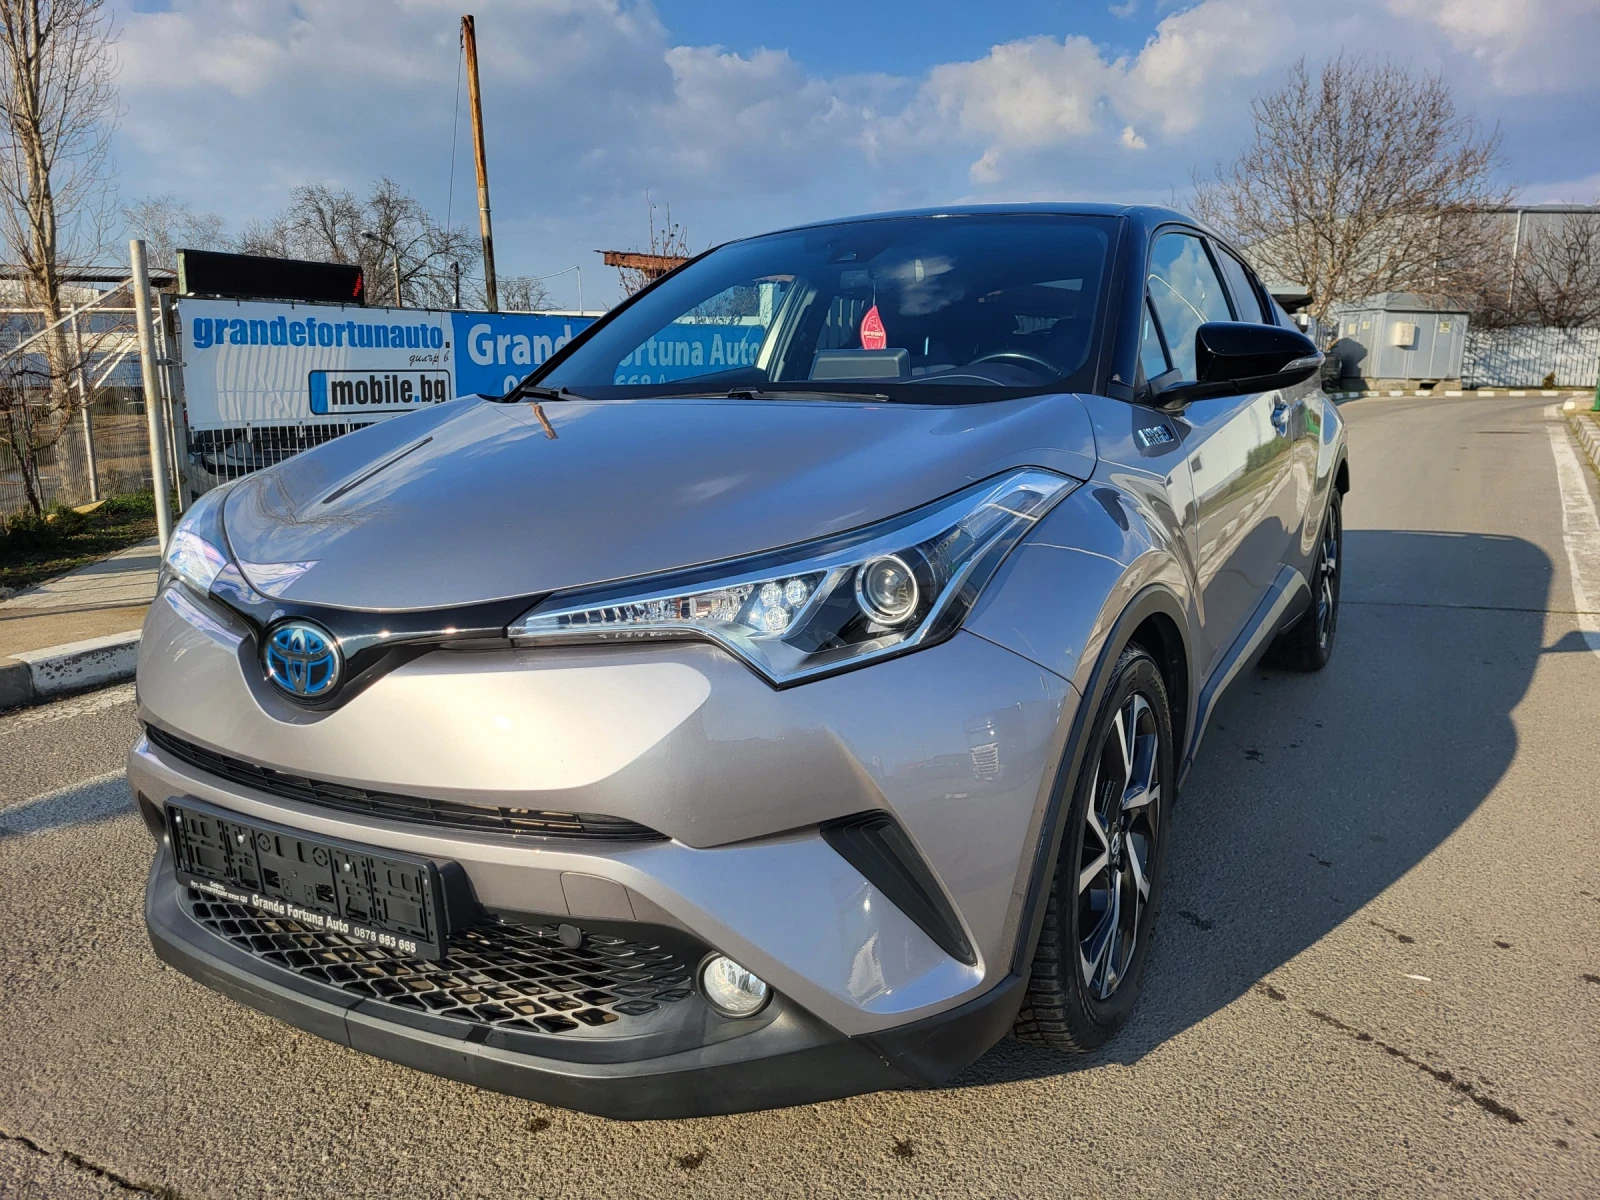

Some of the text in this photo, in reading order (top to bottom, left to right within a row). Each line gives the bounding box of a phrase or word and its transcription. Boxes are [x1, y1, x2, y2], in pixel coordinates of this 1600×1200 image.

[193, 316, 450, 349] grandefortunauto.
[467, 323, 572, 366] Grand
[331, 374, 446, 404] mobile.bg
[252, 894, 417, 953] Grande Fortuna Auto 0878 663 668
